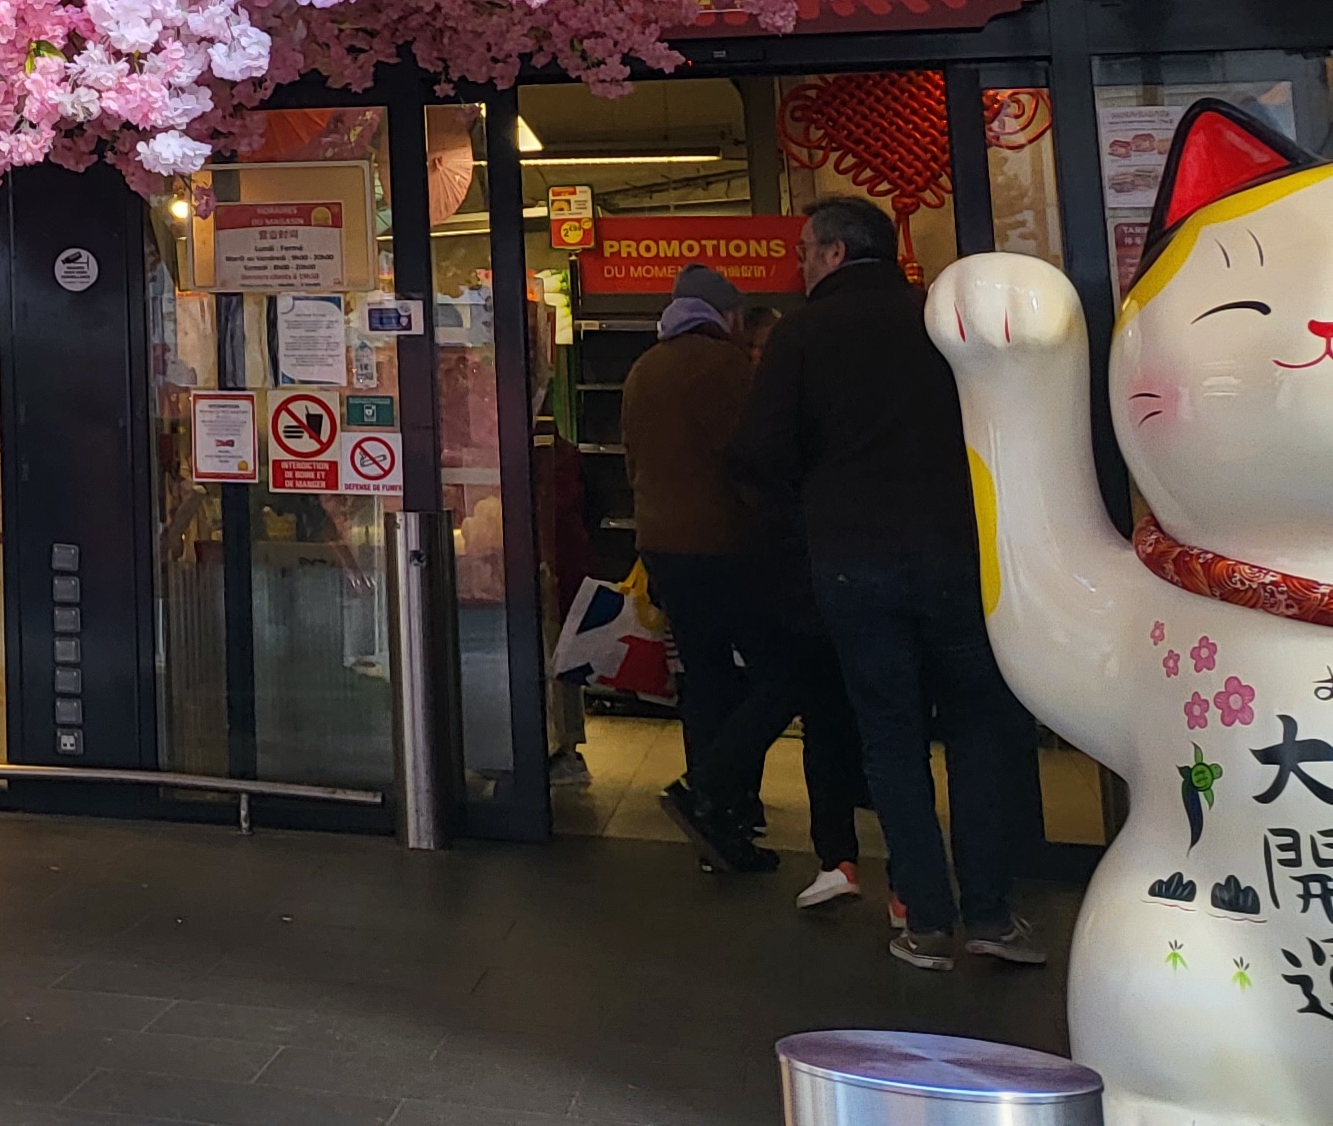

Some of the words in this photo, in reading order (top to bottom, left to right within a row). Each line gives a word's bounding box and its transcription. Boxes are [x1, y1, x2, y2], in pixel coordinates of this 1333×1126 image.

[603, 240, 786, 258] PROMOTIONS
[604, 265, 625, 278] DU
[281, 461, 329, 471] INTERDICTION
